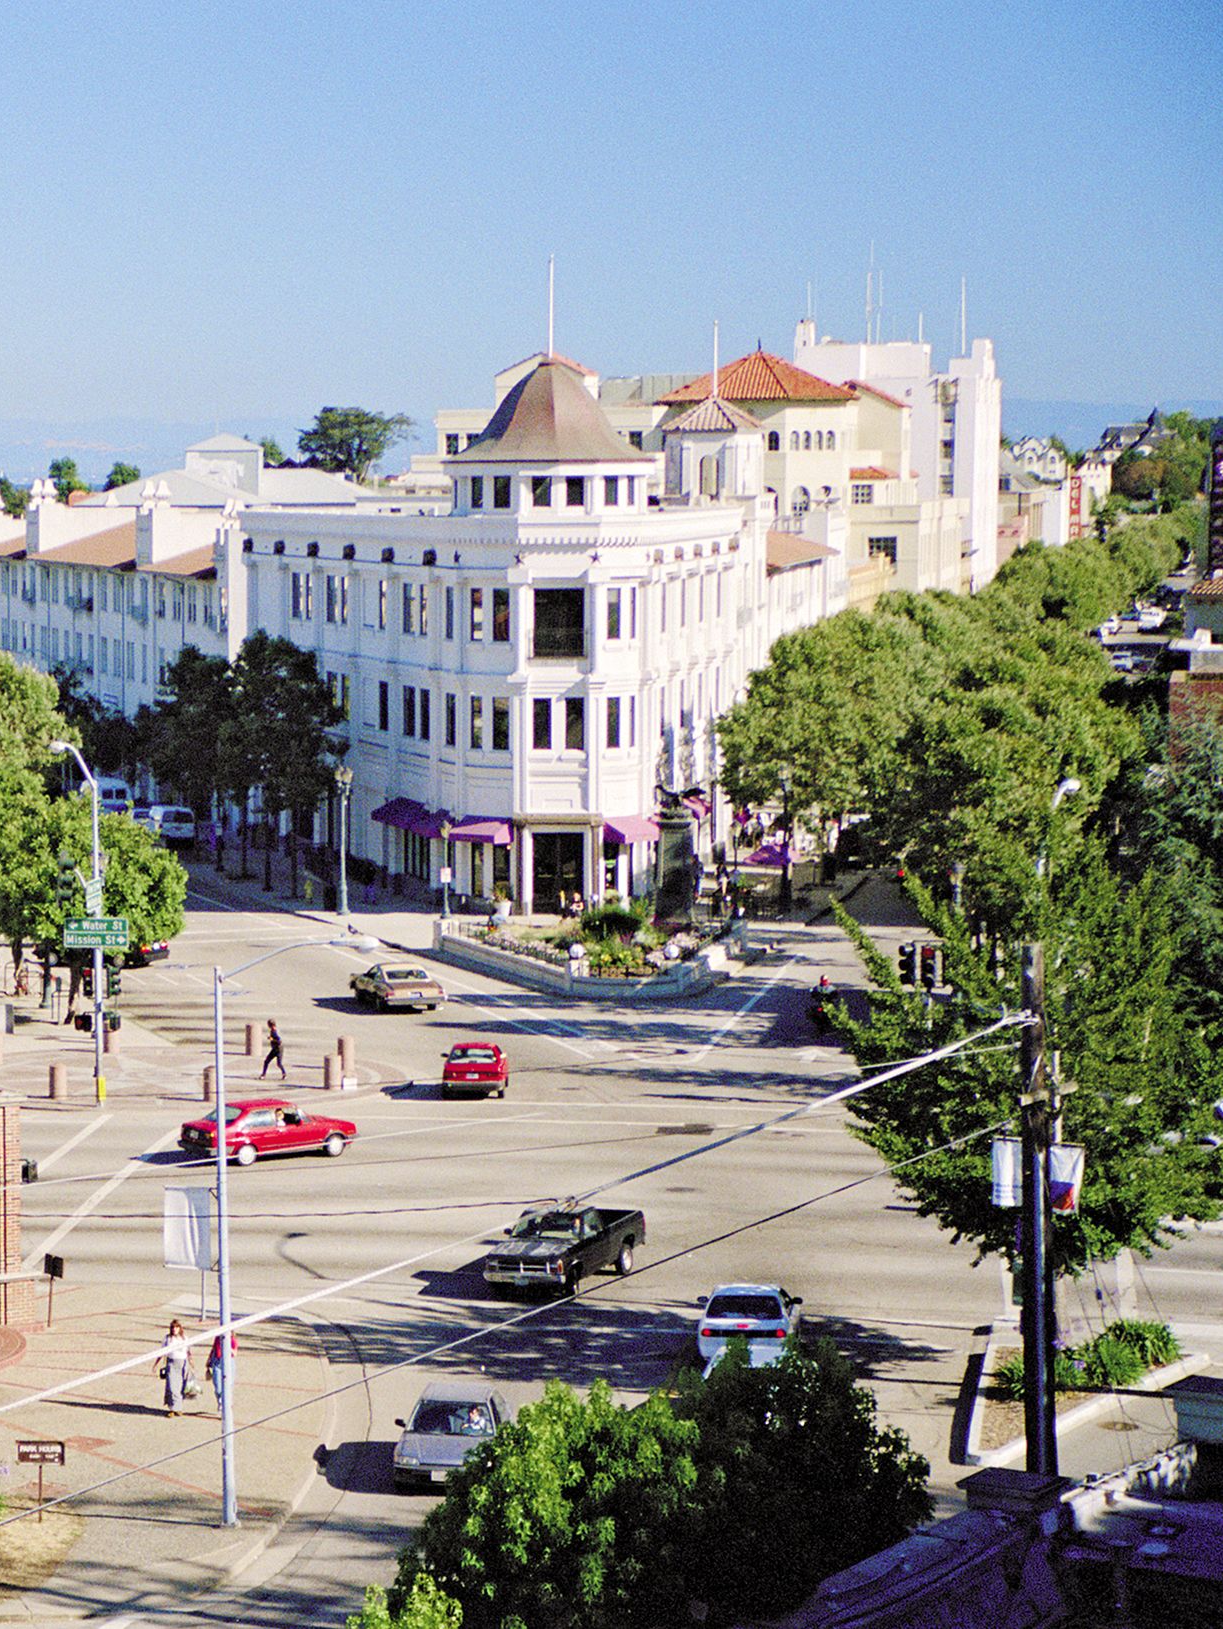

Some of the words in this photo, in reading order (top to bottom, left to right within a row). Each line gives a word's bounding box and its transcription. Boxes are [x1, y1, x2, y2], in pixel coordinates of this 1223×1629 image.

[81, 919, 108, 930] Water
[112, 919, 123, 930] St
[66, 934, 102, 945] Mission
[105, 934, 116, 945] St
